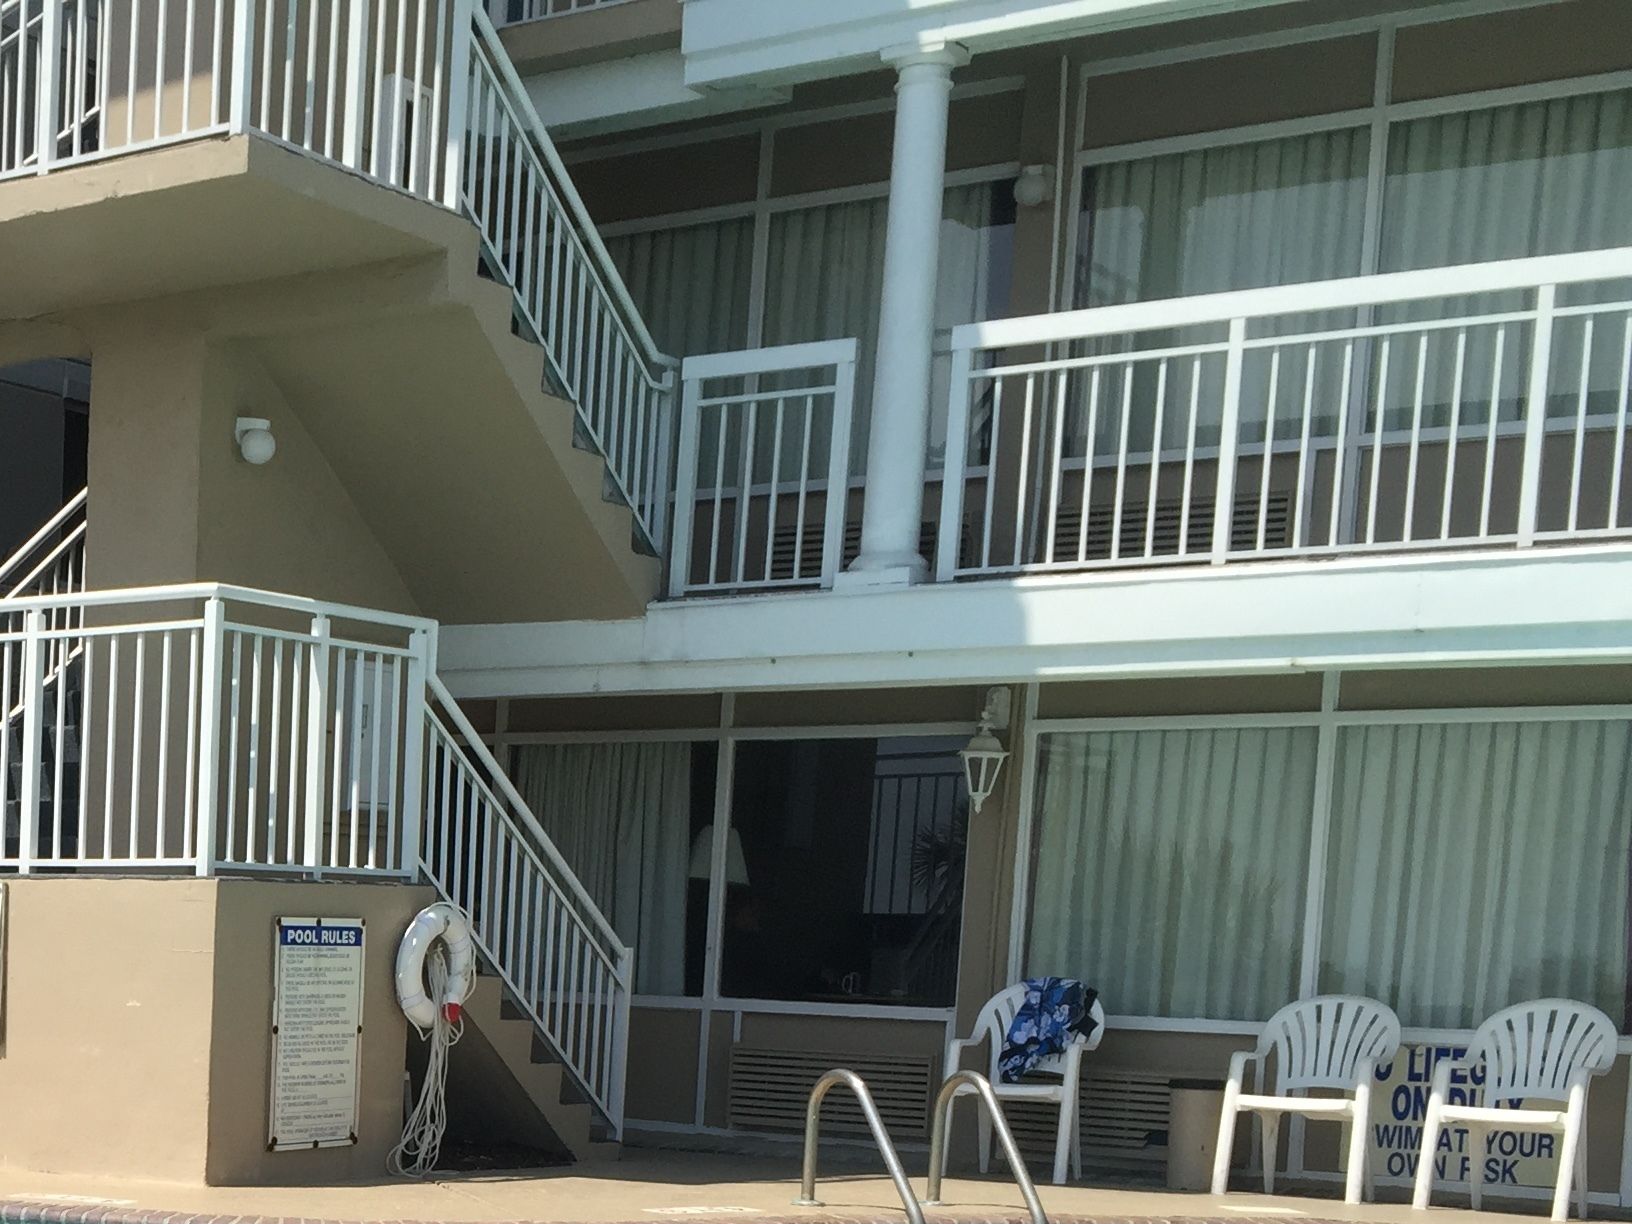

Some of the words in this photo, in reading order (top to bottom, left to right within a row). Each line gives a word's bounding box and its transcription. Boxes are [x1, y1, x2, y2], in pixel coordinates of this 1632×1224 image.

[287, 929, 319, 944] POOL
[321, 930, 356, 944] RULES
[1391, 1084, 1430, 1121] ON
[1373, 1123, 1423, 1150] WIM
[1436, 1127, 1469, 1153] AT
[1485, 1130, 1555, 1158] YOUR
[1459, 1155, 1520, 1184] RSK
